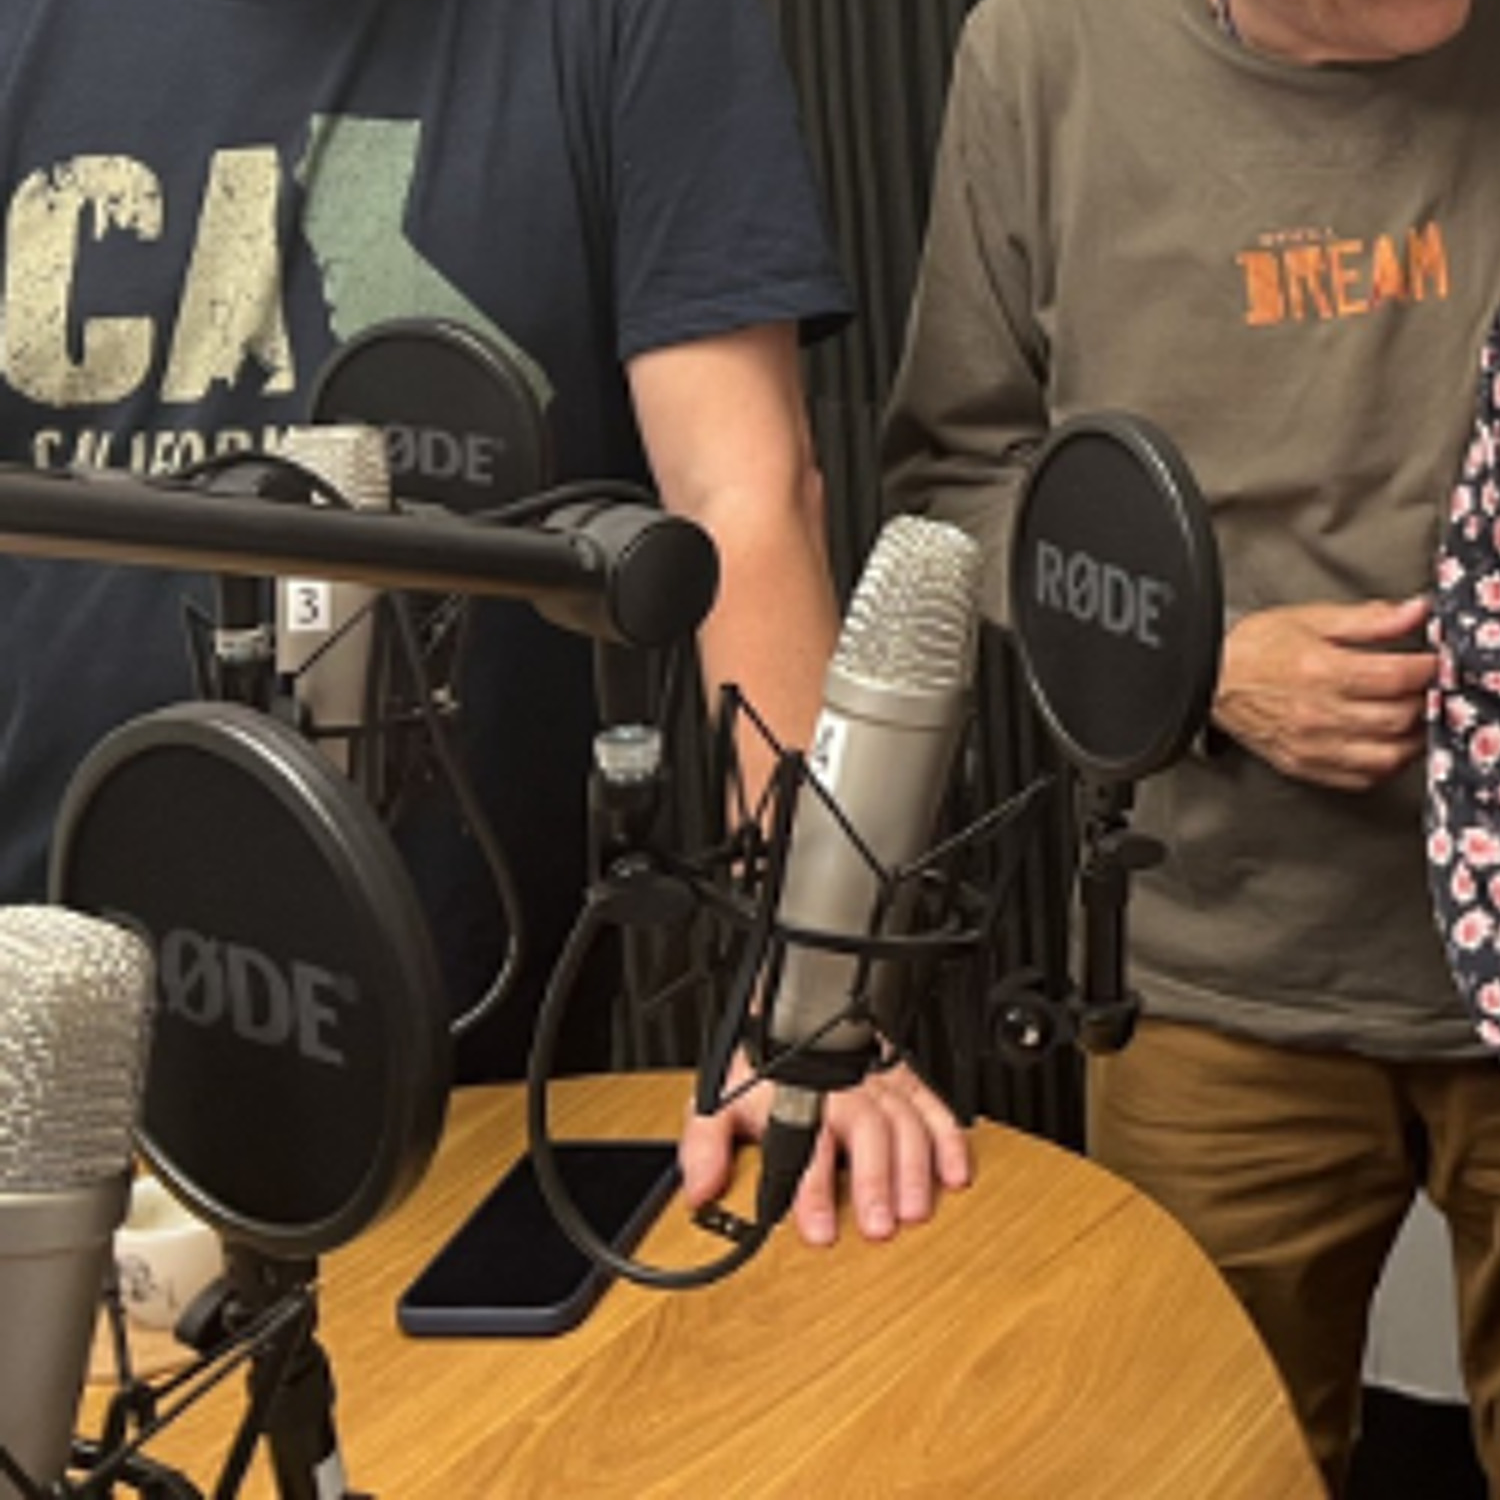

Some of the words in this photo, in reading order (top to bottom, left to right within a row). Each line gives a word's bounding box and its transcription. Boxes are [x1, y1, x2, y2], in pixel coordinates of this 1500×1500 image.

[0, 146, 296, 407] CA
[1235, 220, 1449, 326] DREAM
[384, 423, 494, 485] ØDE
[298, 587, 320, 625] 3
[1036, 538, 1161, 648] RØDE
[160, 928, 346, 1067] ØDE
